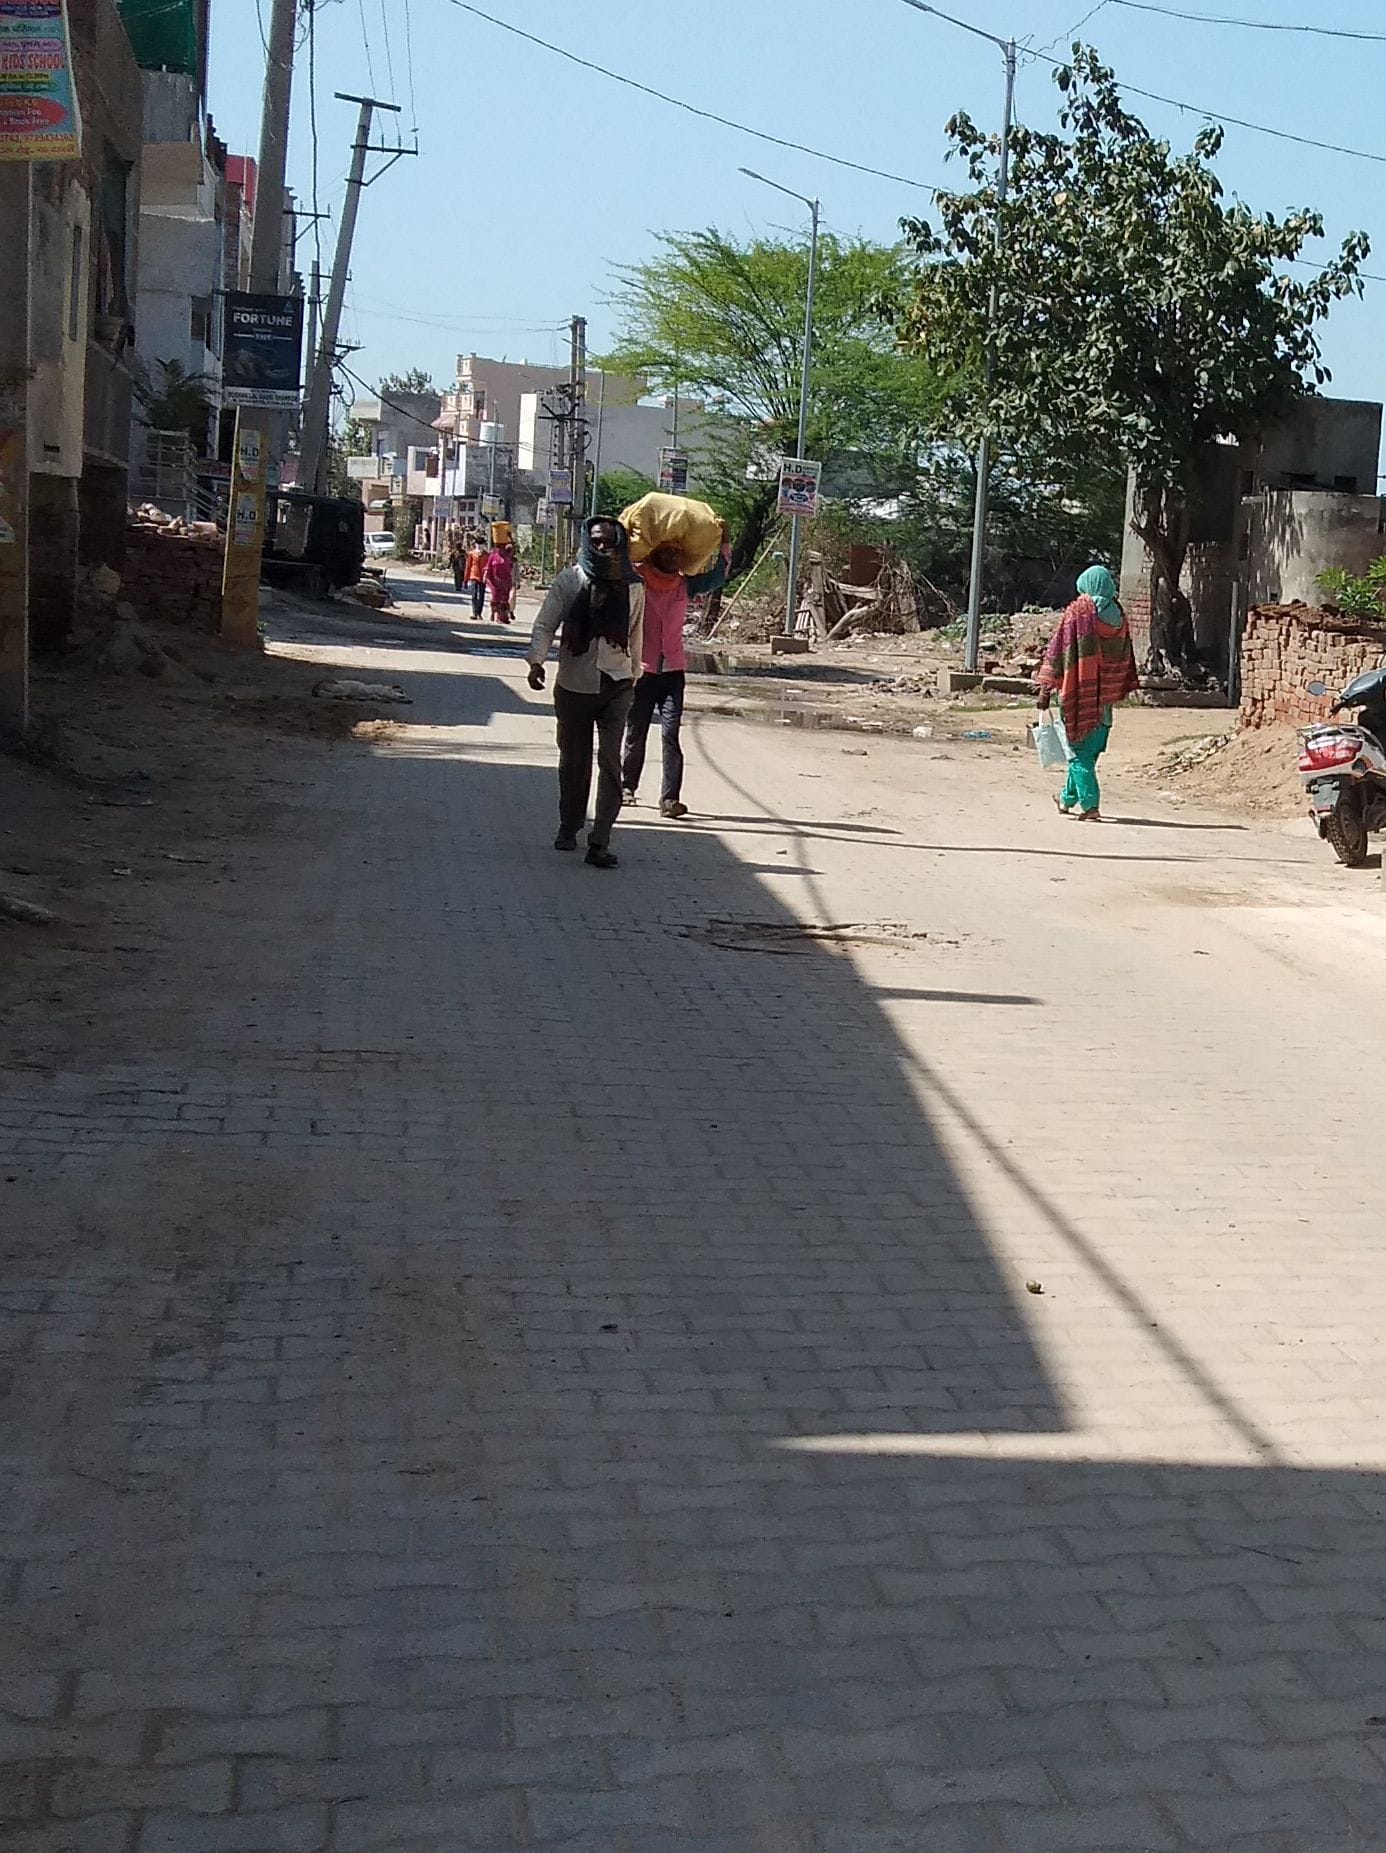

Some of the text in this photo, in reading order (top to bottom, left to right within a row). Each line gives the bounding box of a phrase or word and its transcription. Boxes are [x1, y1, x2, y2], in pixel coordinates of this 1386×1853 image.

[28, 51, 65, 69] SCHOOL
[233, 312, 293, 326] FORTUNE
[783, 463, 803, 474] H.D
